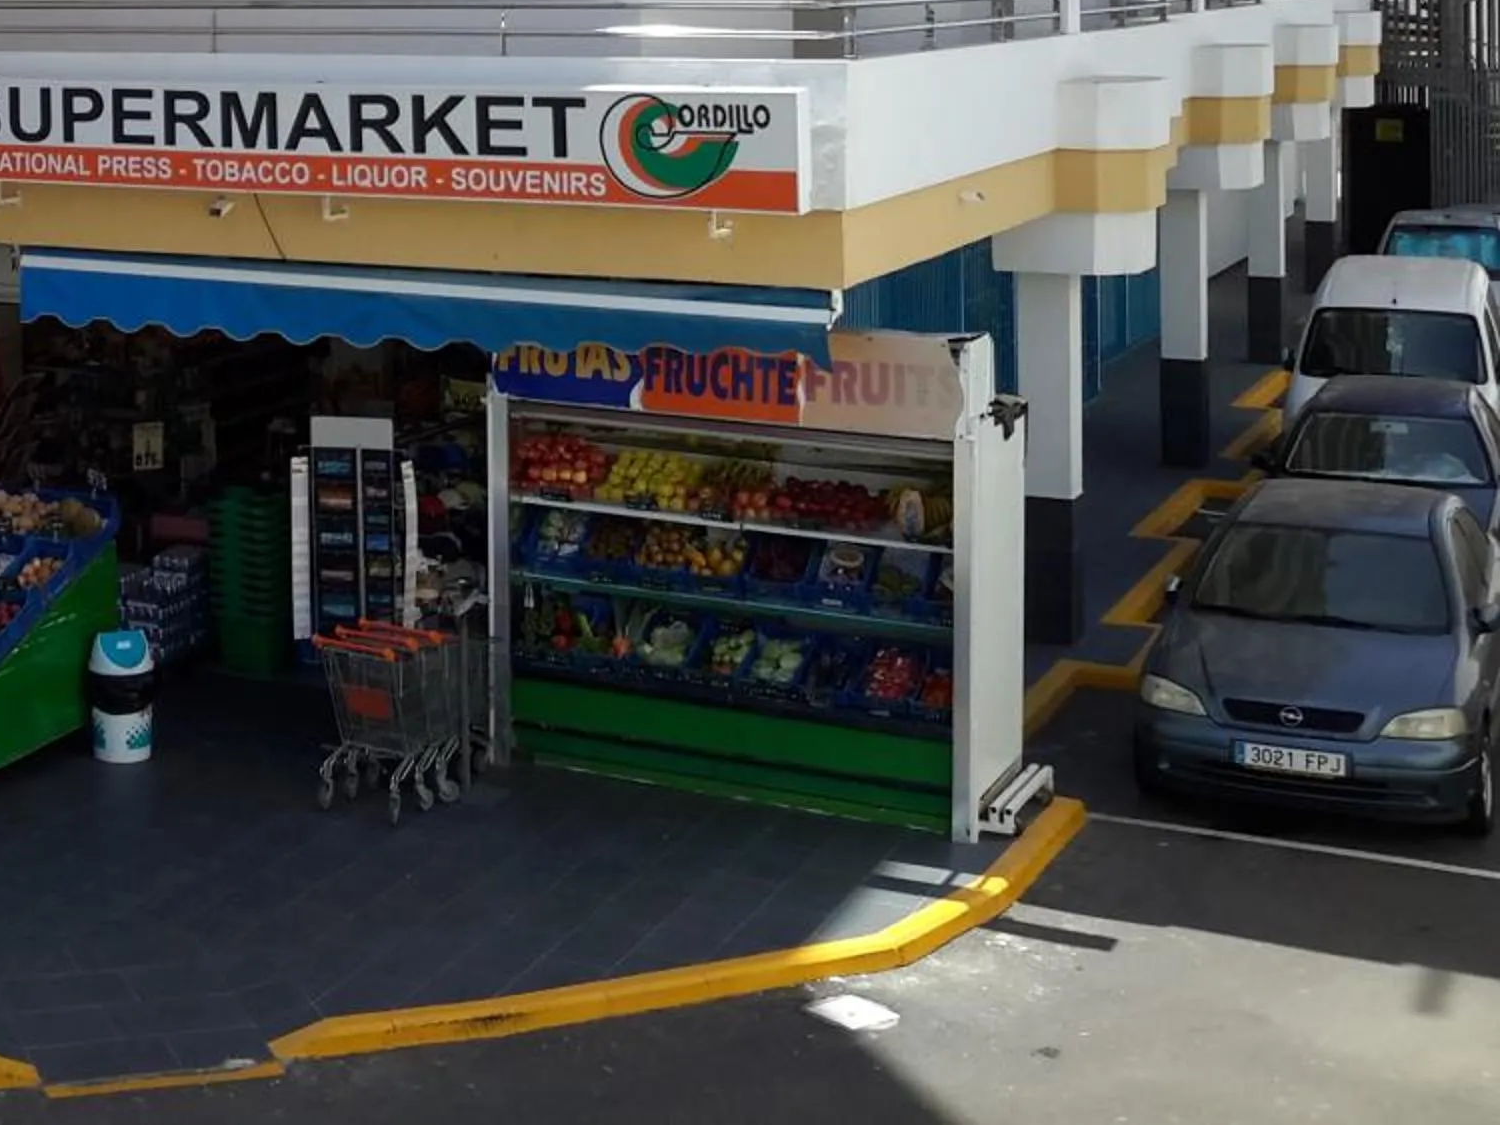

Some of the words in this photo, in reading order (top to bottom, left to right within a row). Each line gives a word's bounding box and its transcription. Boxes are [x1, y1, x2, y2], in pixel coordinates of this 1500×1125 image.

[97, 155, 172, 181] PRESS
[192, 158, 311, 187] TOBACCO
[331, 165, 428, 191] LIQUOR
[450, 170, 607, 197] SOUVENIRS
[1251, 746, 1293, 768] 3021
[1304, 752, 1341, 773] FPJ
